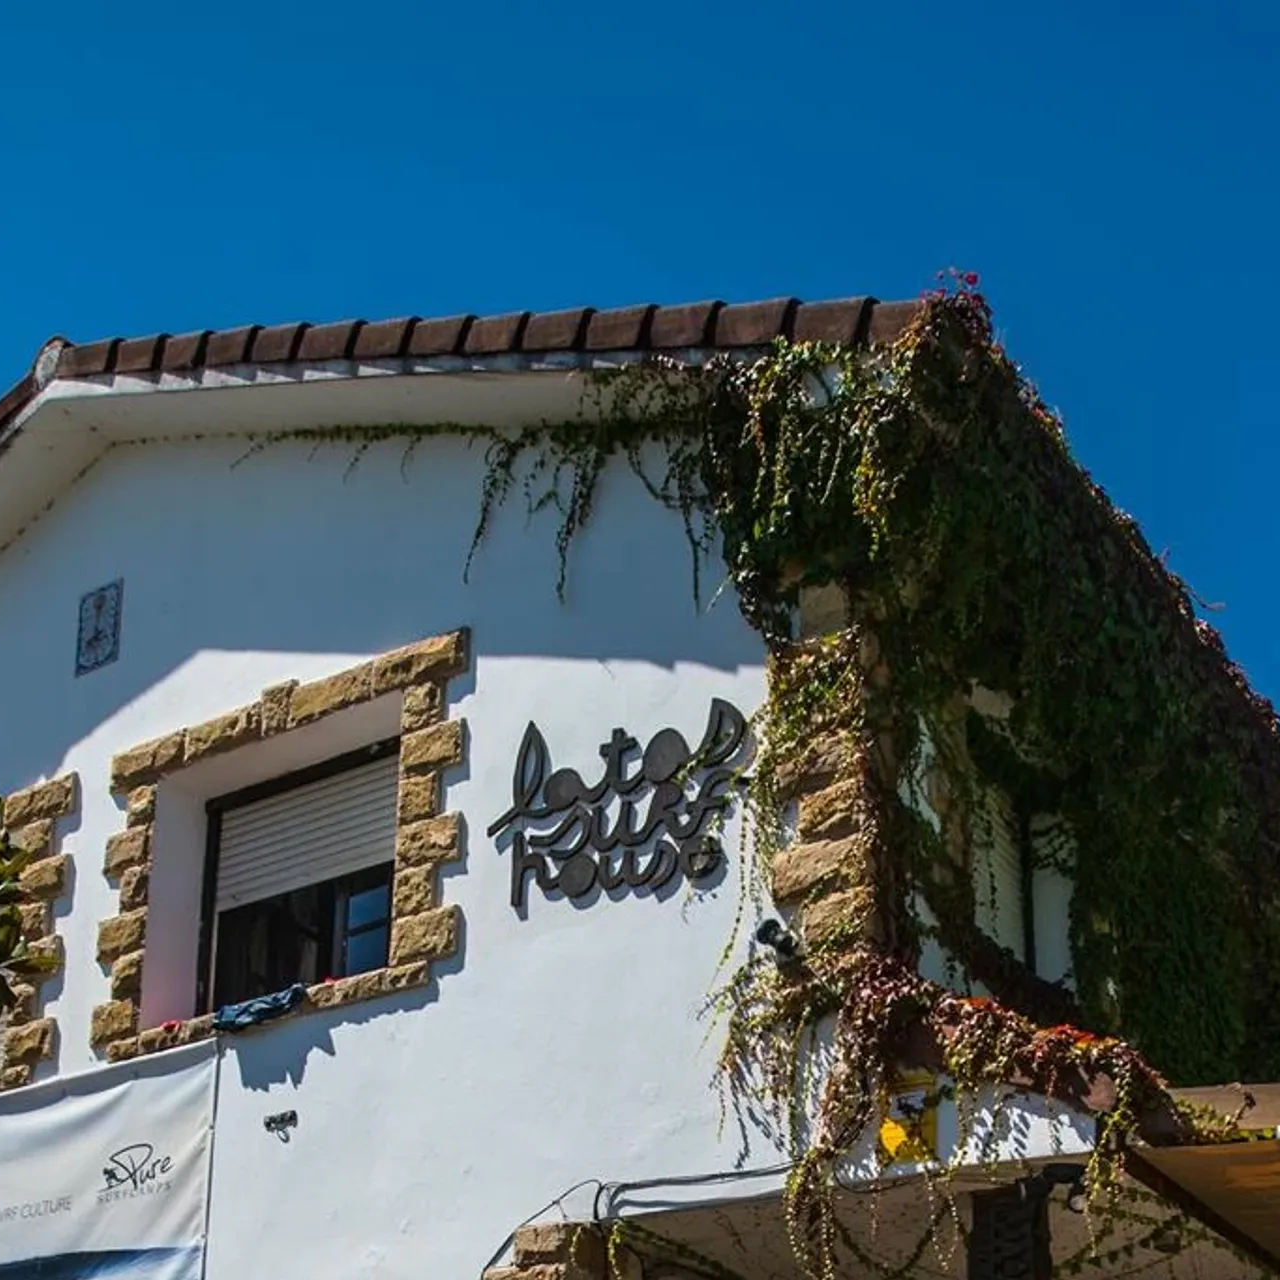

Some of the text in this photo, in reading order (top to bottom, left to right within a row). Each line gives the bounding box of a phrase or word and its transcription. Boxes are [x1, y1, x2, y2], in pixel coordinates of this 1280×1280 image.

[511, 830, 726, 908] house
[108, 1143, 174, 1191] Pure
[20, 1195, 73, 1219] CULTURE
